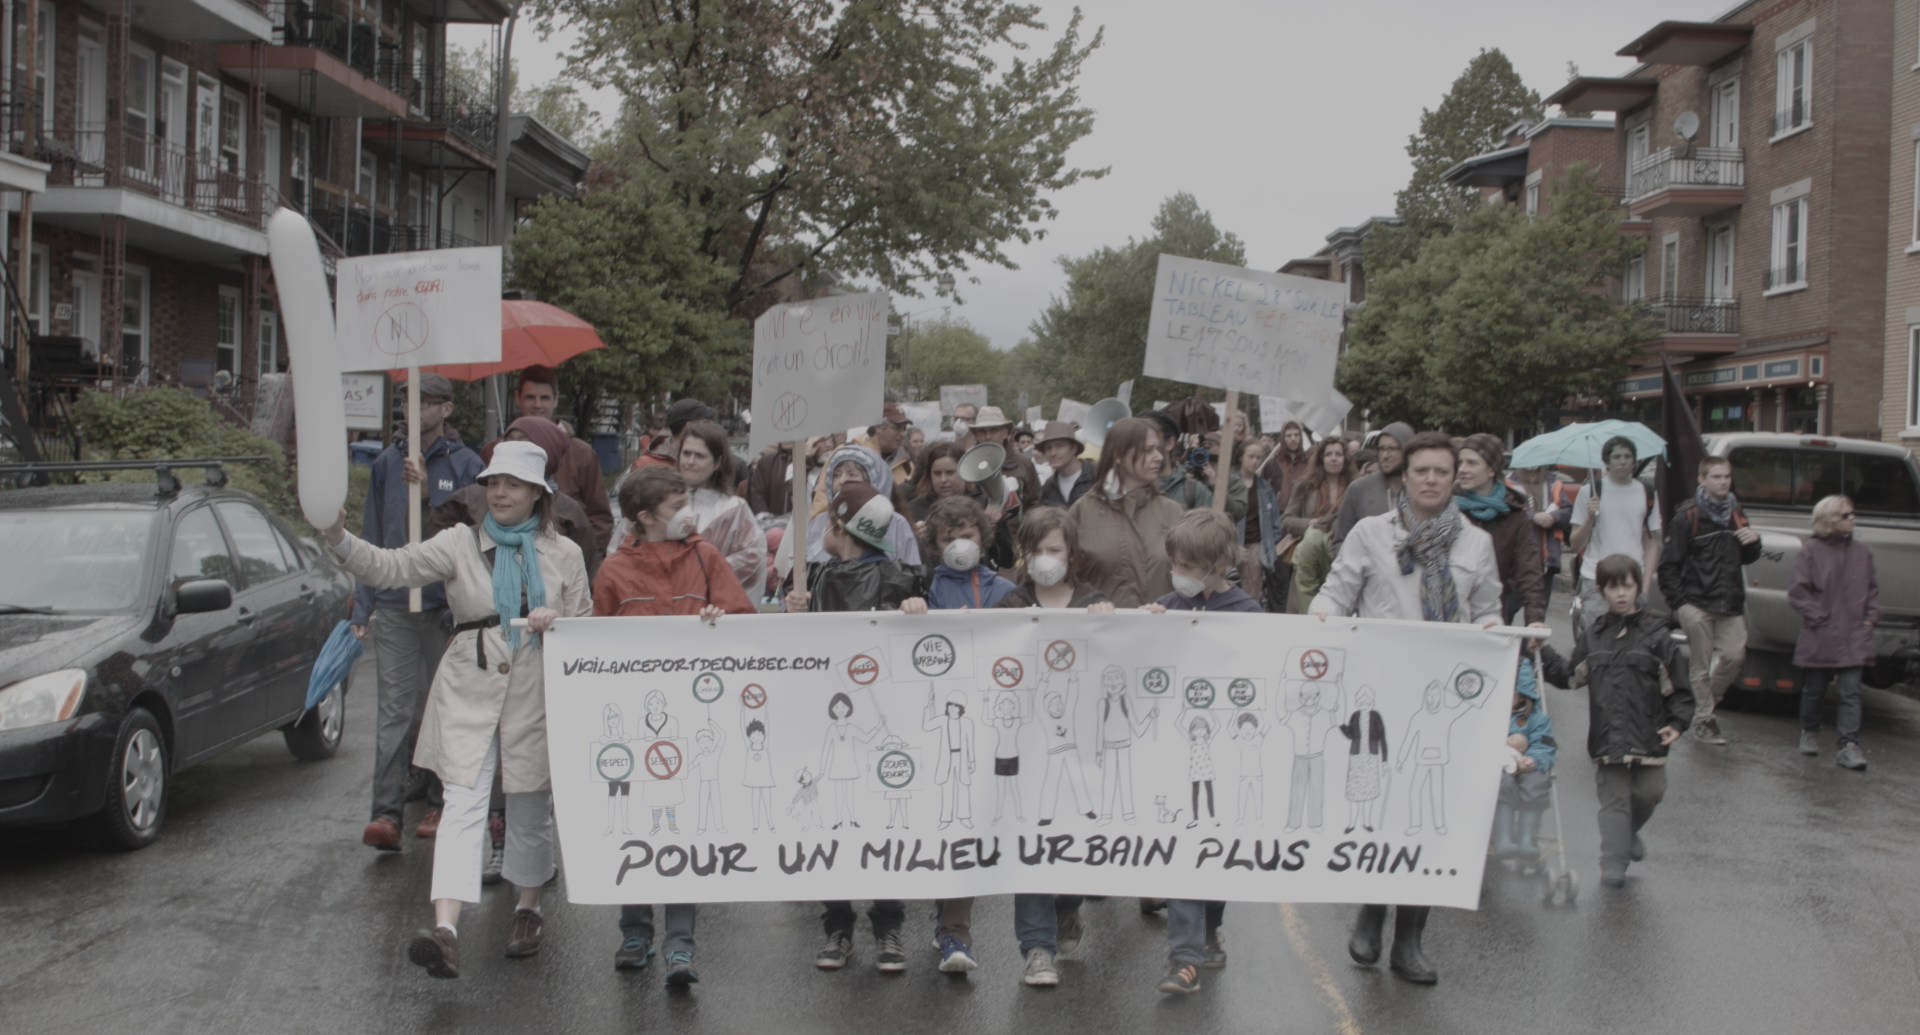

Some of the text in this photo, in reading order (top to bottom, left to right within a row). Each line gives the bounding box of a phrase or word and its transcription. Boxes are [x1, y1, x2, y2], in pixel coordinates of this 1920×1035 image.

[1163, 298, 1249, 327] TABLEAU
[783, 348, 805, 373] un
[600, 757, 629, 767] RESPECT
[882, 759, 910, 770] JOUER
[616, 839, 758, 885] POUR
[778, 840, 839, 873] UN
[860, 835, 1004, 872] MILIEU
[1018, 833, 1178, 869] URBAIN
[1194, 837, 1311, 873] PLUS
